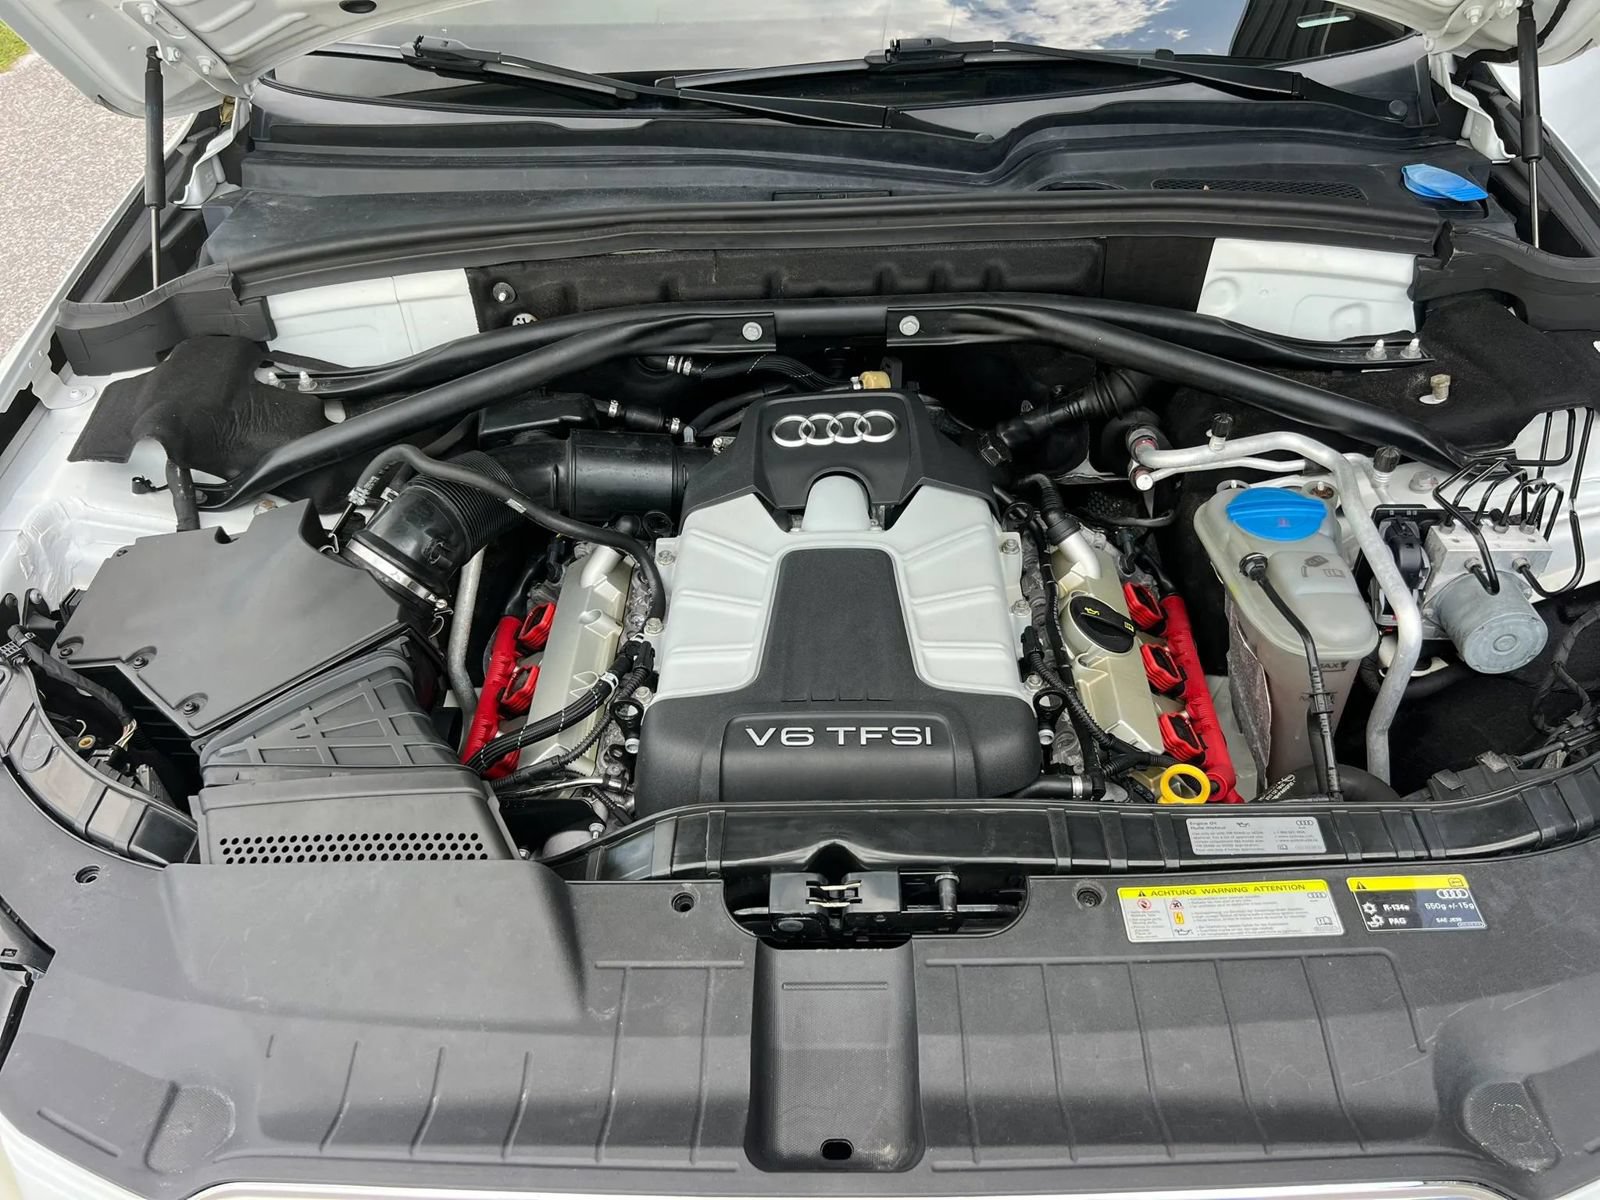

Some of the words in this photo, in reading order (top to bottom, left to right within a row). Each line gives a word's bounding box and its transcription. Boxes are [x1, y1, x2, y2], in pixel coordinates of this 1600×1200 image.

[745, 727, 815, 747] V6
[826, 726, 932, 746] TFSI
[1151, 889, 1197, 897] ACHTUNG
[1200, 886, 1249, 895] WARNING
[1253, 884, 1306, 892] ATTENTION
[1424, 902, 1447, 911] 550g
[1388, 917, 1407, 926] PAG
